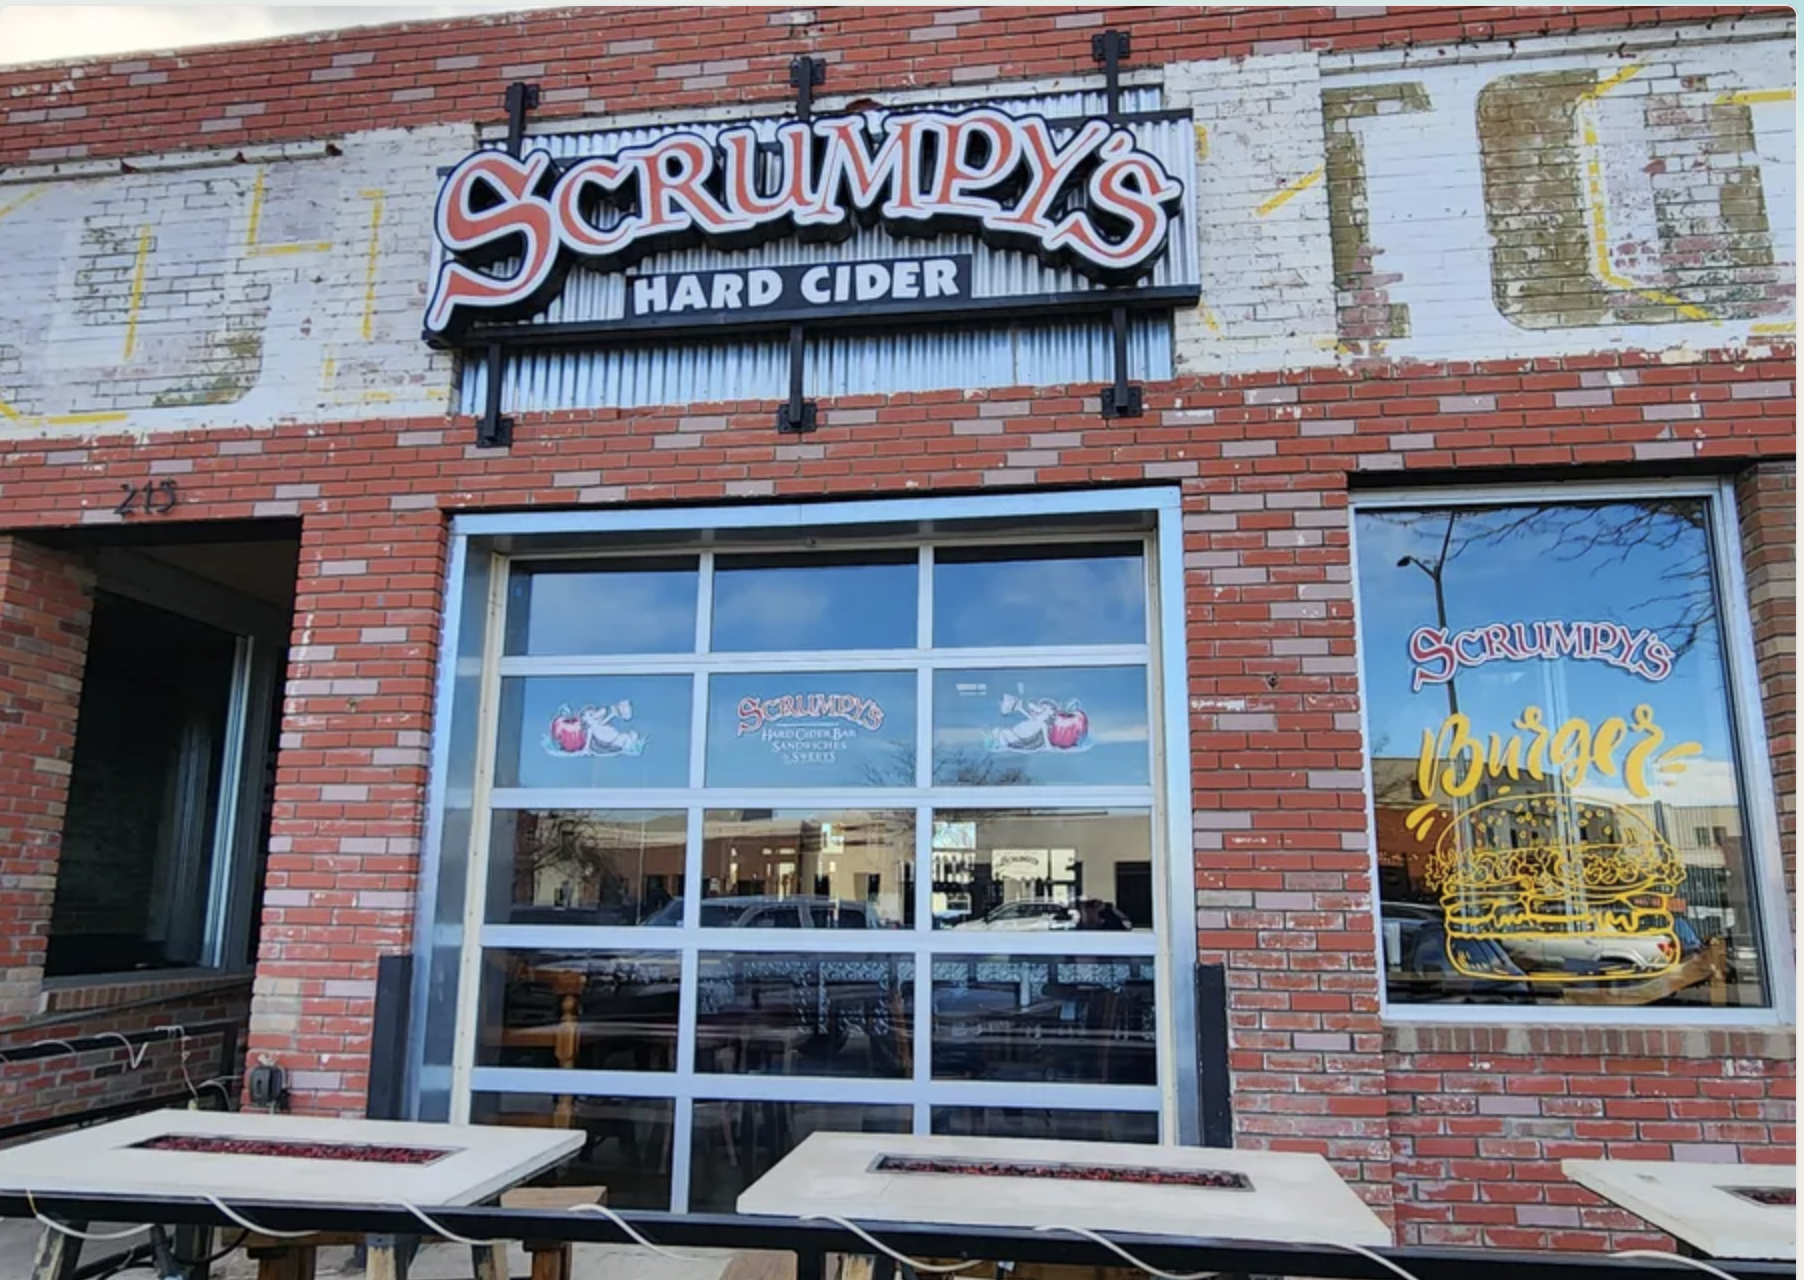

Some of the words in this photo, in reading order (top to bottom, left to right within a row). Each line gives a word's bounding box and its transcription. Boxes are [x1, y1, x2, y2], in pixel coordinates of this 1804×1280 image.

[424, 107, 1184, 333] SCRUMPY'S
[633, 268, 783, 315] HARD
[801, 258, 960, 305] CIDER
[113, 479, 177, 515] 215
[1410, 620, 1677, 692] SCRUMPY'S
[736, 694, 885, 737] SCRUMPY'S
[761, 728, 794, 742] HARD
[795, 727, 831, 741] CIDER
[833, 727, 857, 740] BAR
[1417, 703, 1665, 798] Burger
